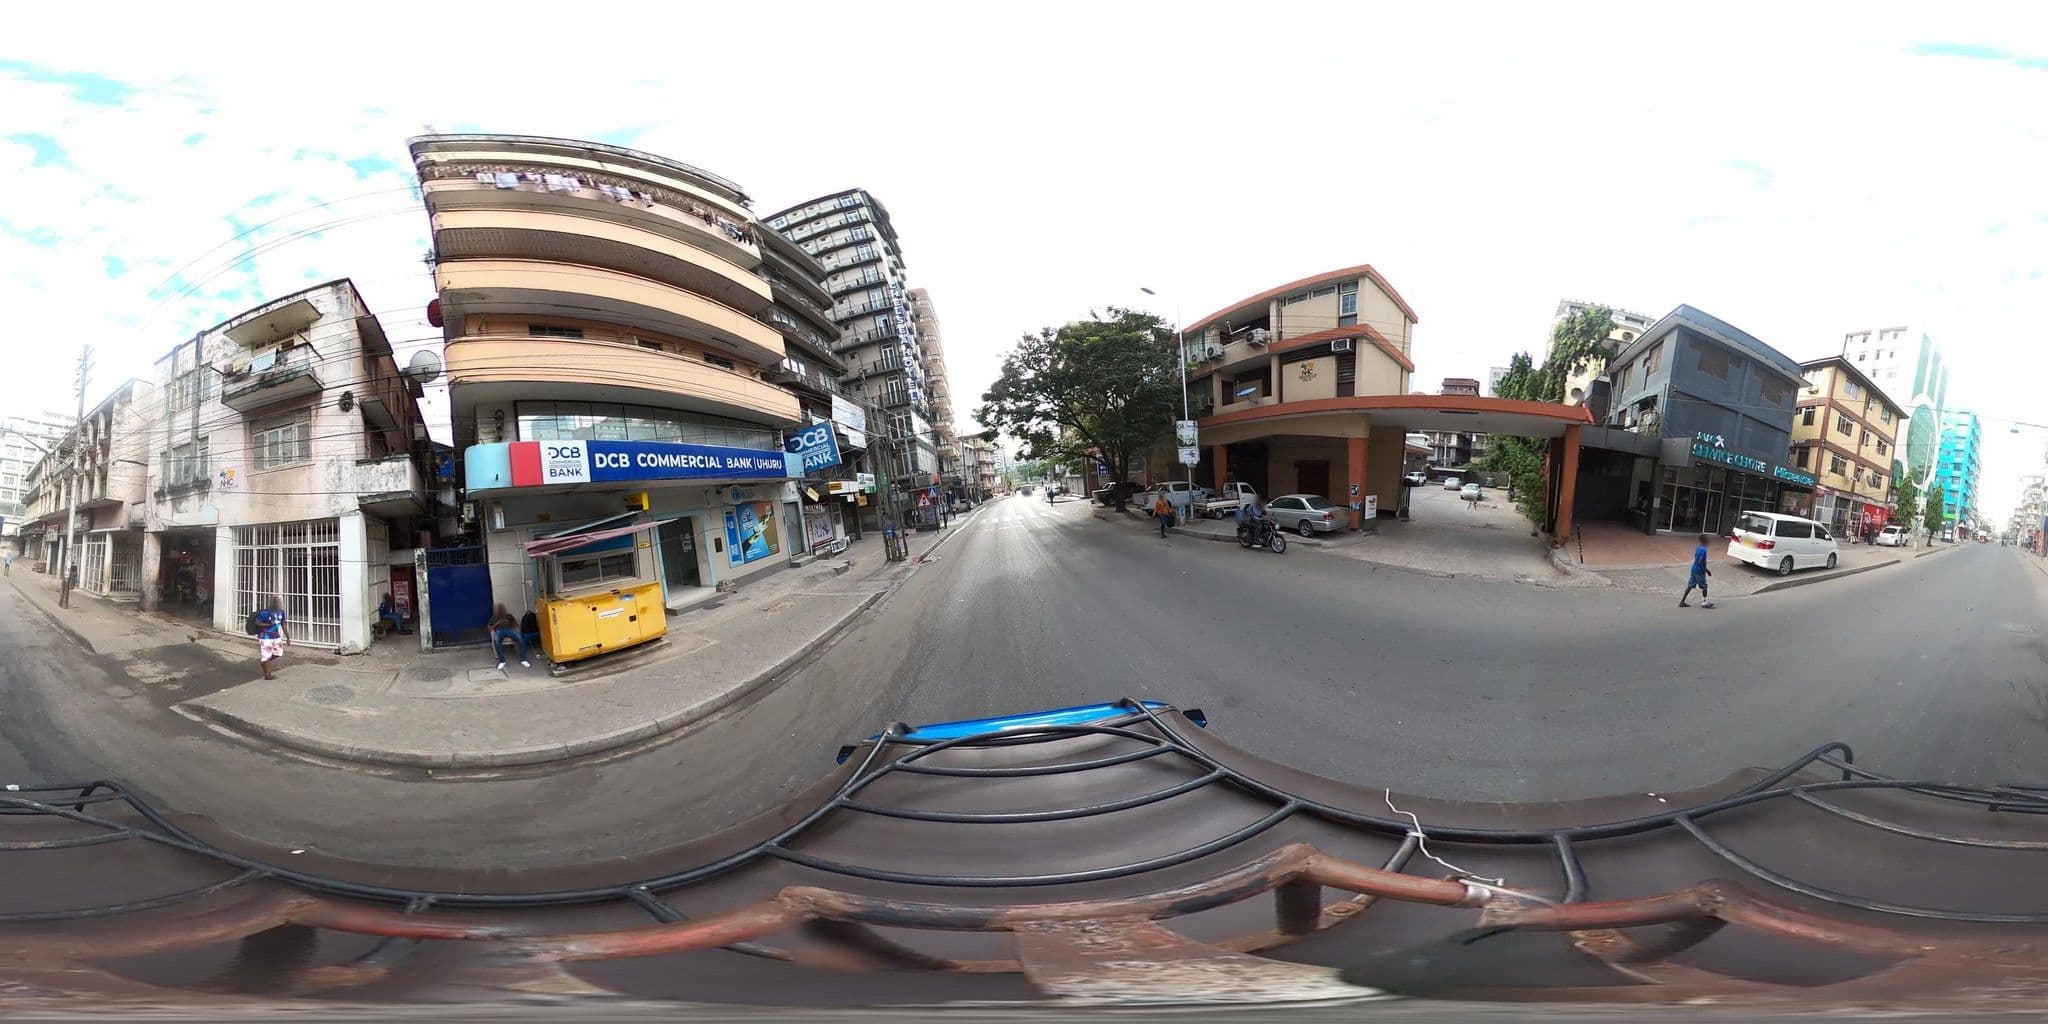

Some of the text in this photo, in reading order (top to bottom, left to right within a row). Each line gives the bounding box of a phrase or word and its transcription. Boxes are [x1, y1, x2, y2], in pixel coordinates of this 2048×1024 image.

[890, 284, 918, 400] CHELSEA HOTEL
[790, 428, 828, 451] DCB
[547, 446, 582, 459] DCB
[804, 452, 833, 469] ANK
[1692, 443, 1766, 473] SERVICE CENTRE
[594, 453, 782, 470] DCB COMMERCIAL BANK UHURU
[549, 468, 583, 478] BANK
